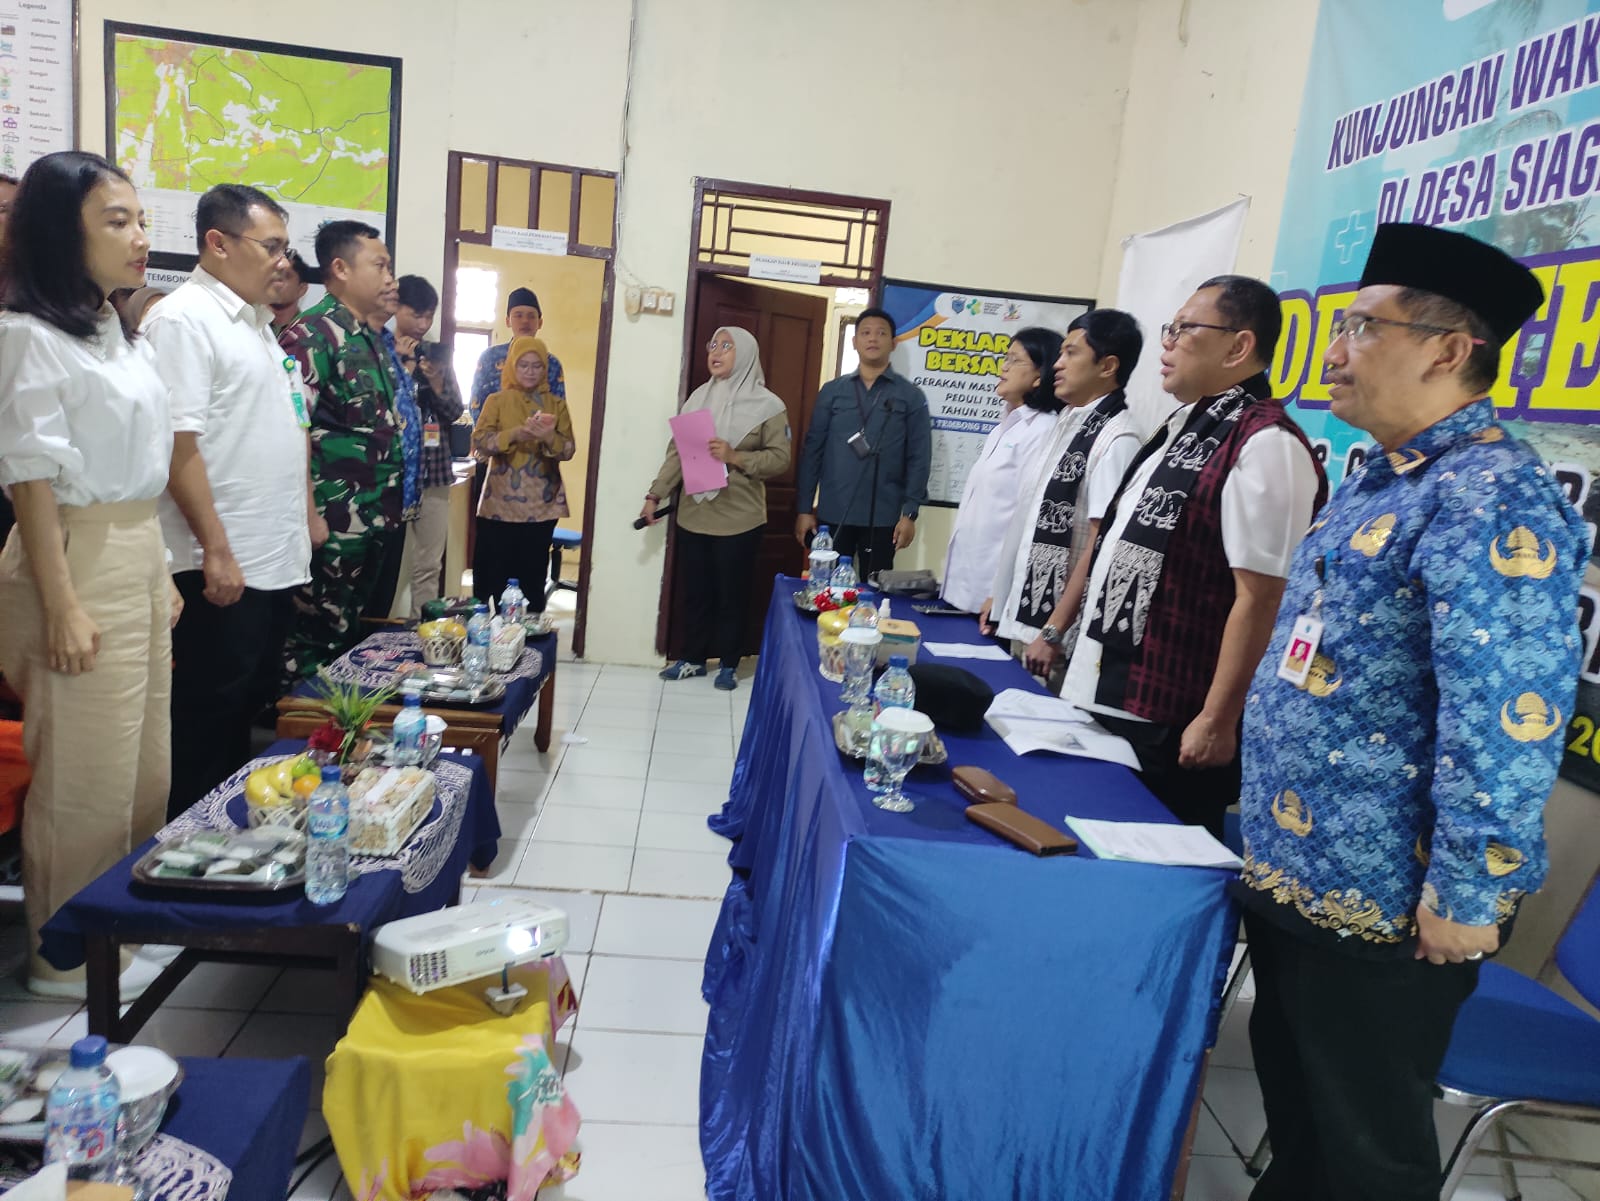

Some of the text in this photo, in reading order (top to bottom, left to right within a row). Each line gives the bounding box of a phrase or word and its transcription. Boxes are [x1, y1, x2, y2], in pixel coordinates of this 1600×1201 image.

[1326, 16, 1600, 170] KUNJUNGAN WAK
[1377, 123, 1600, 227] DI DESA SIAG
[1269, 291, 1359, 400] DE
[913, 376, 966, 390] GERAKAN
[941, 405, 978, 417] TAHUN
[945, 392, 983, 405] PEDULI
